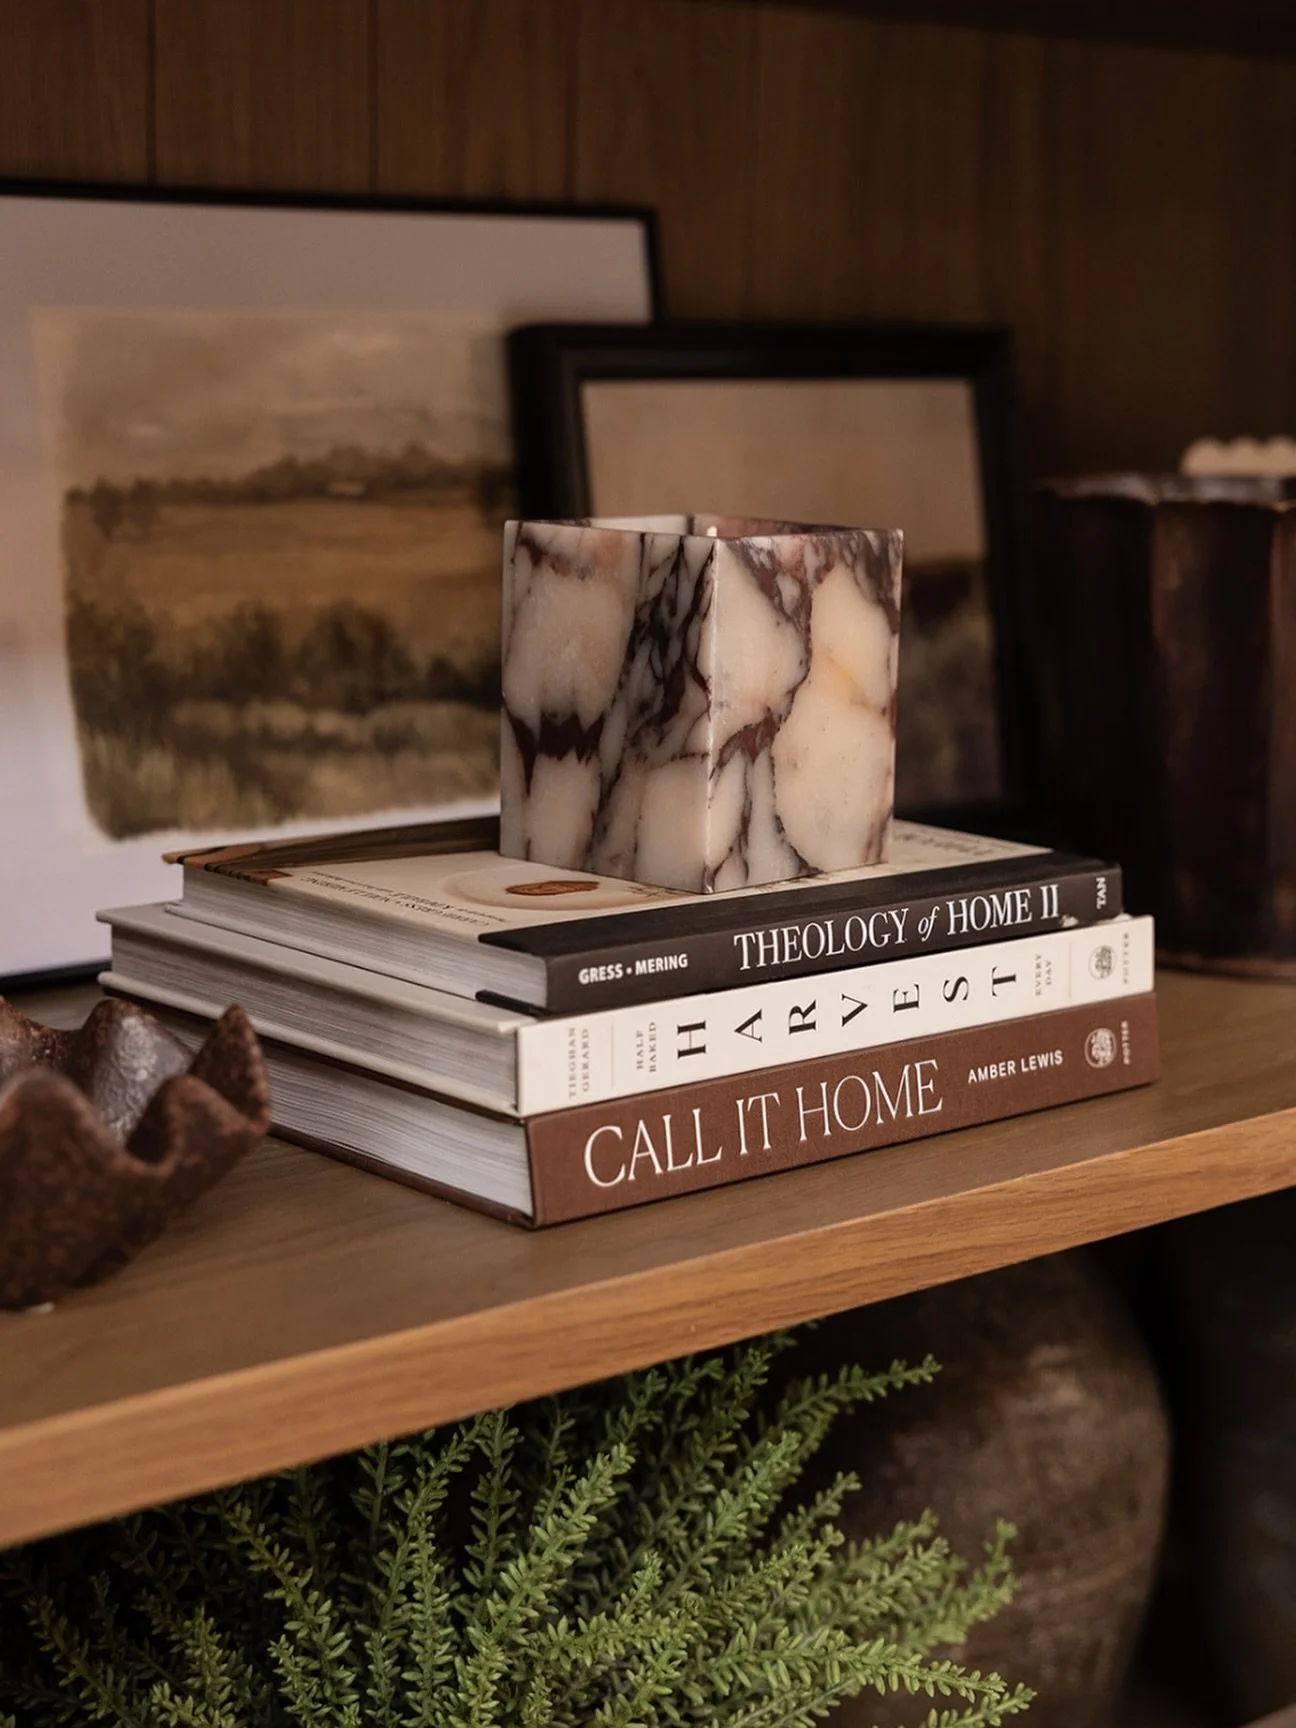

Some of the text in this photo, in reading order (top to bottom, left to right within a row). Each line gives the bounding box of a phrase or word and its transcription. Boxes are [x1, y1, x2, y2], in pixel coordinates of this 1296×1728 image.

[733, 884, 1060, 971] THEOLOGY of HOME II
[578, 953, 688, 985] GRESS MERING
[1034, 953, 1042, 996] EVERY
[677, 966, 1017, 1060] HARVEST
[582, 1028, 590, 1092] GERARD
[636, 1030, 644, 1070] HALF
[649, 1022, 657, 1073] BAKED
[967, 1050, 1063, 1084] AMBER LEWIS
[584, 1059, 943, 1187] CALL IT HOME
